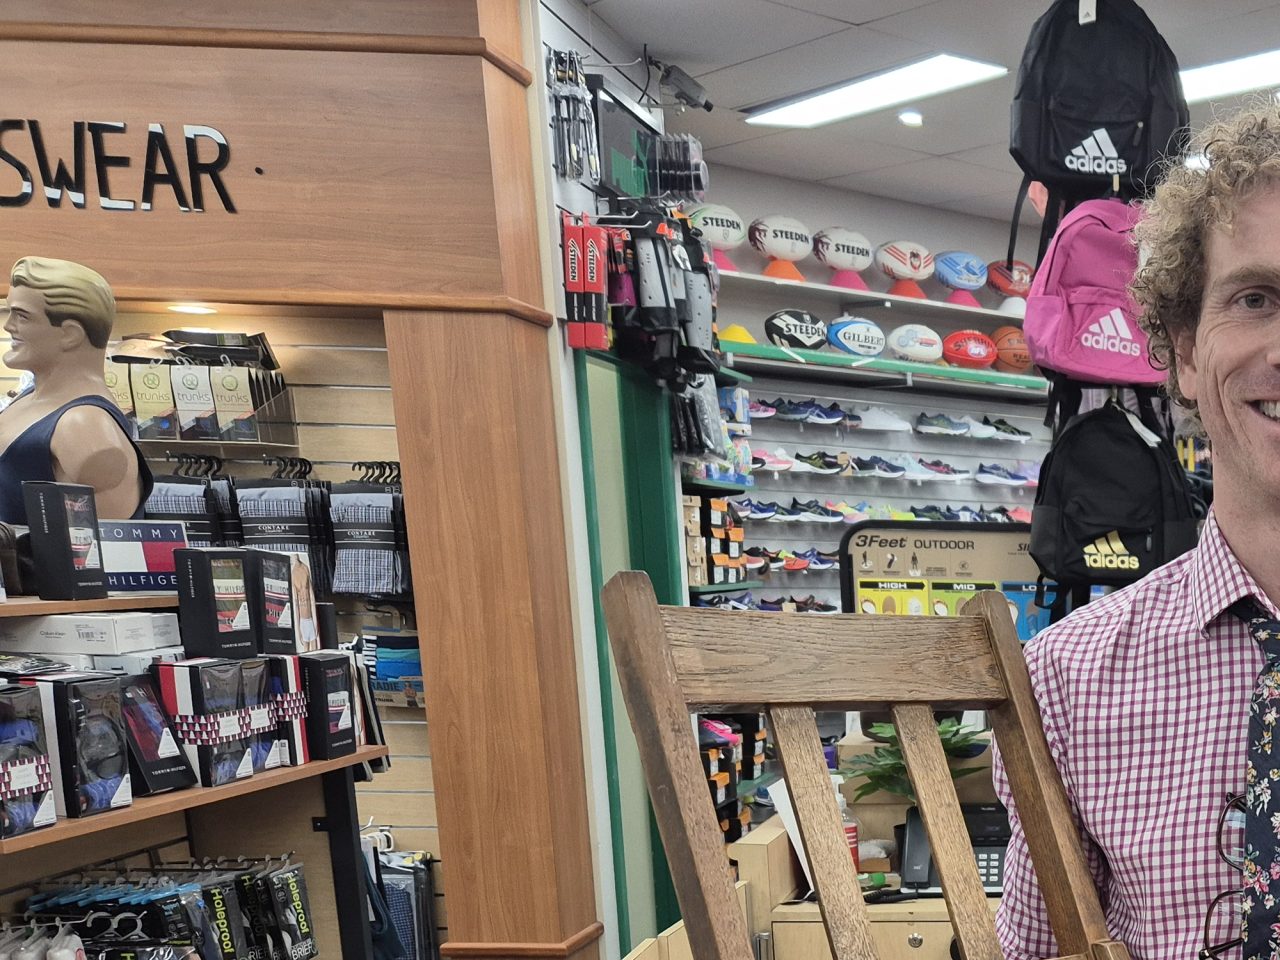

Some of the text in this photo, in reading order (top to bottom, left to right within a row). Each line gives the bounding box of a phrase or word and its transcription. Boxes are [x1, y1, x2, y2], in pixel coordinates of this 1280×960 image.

[0, 119, 238, 214] SWEAR
[1064, 154, 1127, 174] adidas
[702, 216, 741, 231] STEEDEN
[772, 229, 810, 244] STEEDEN
[835, 243, 870, 257] STEEDEN
[570, 249, 578, 281] STEEDEN
[784, 323, 827, 338] STEEDEN
[1081, 332, 1141, 357] adidas
[136, 391, 170, 400] trunks
[177, 392, 211, 402] trunks
[216, 394, 249, 403] trunks
[100, 528, 177, 539] TOMMY
[855, 535, 975, 549] 3Feet OUTDOOR
[109, 576, 178, 586] HILFIGE
[369, 681, 400, 691] RADIE
[286, 873, 309, 934] Holeproof
[211, 888, 235, 953] Holeproof
